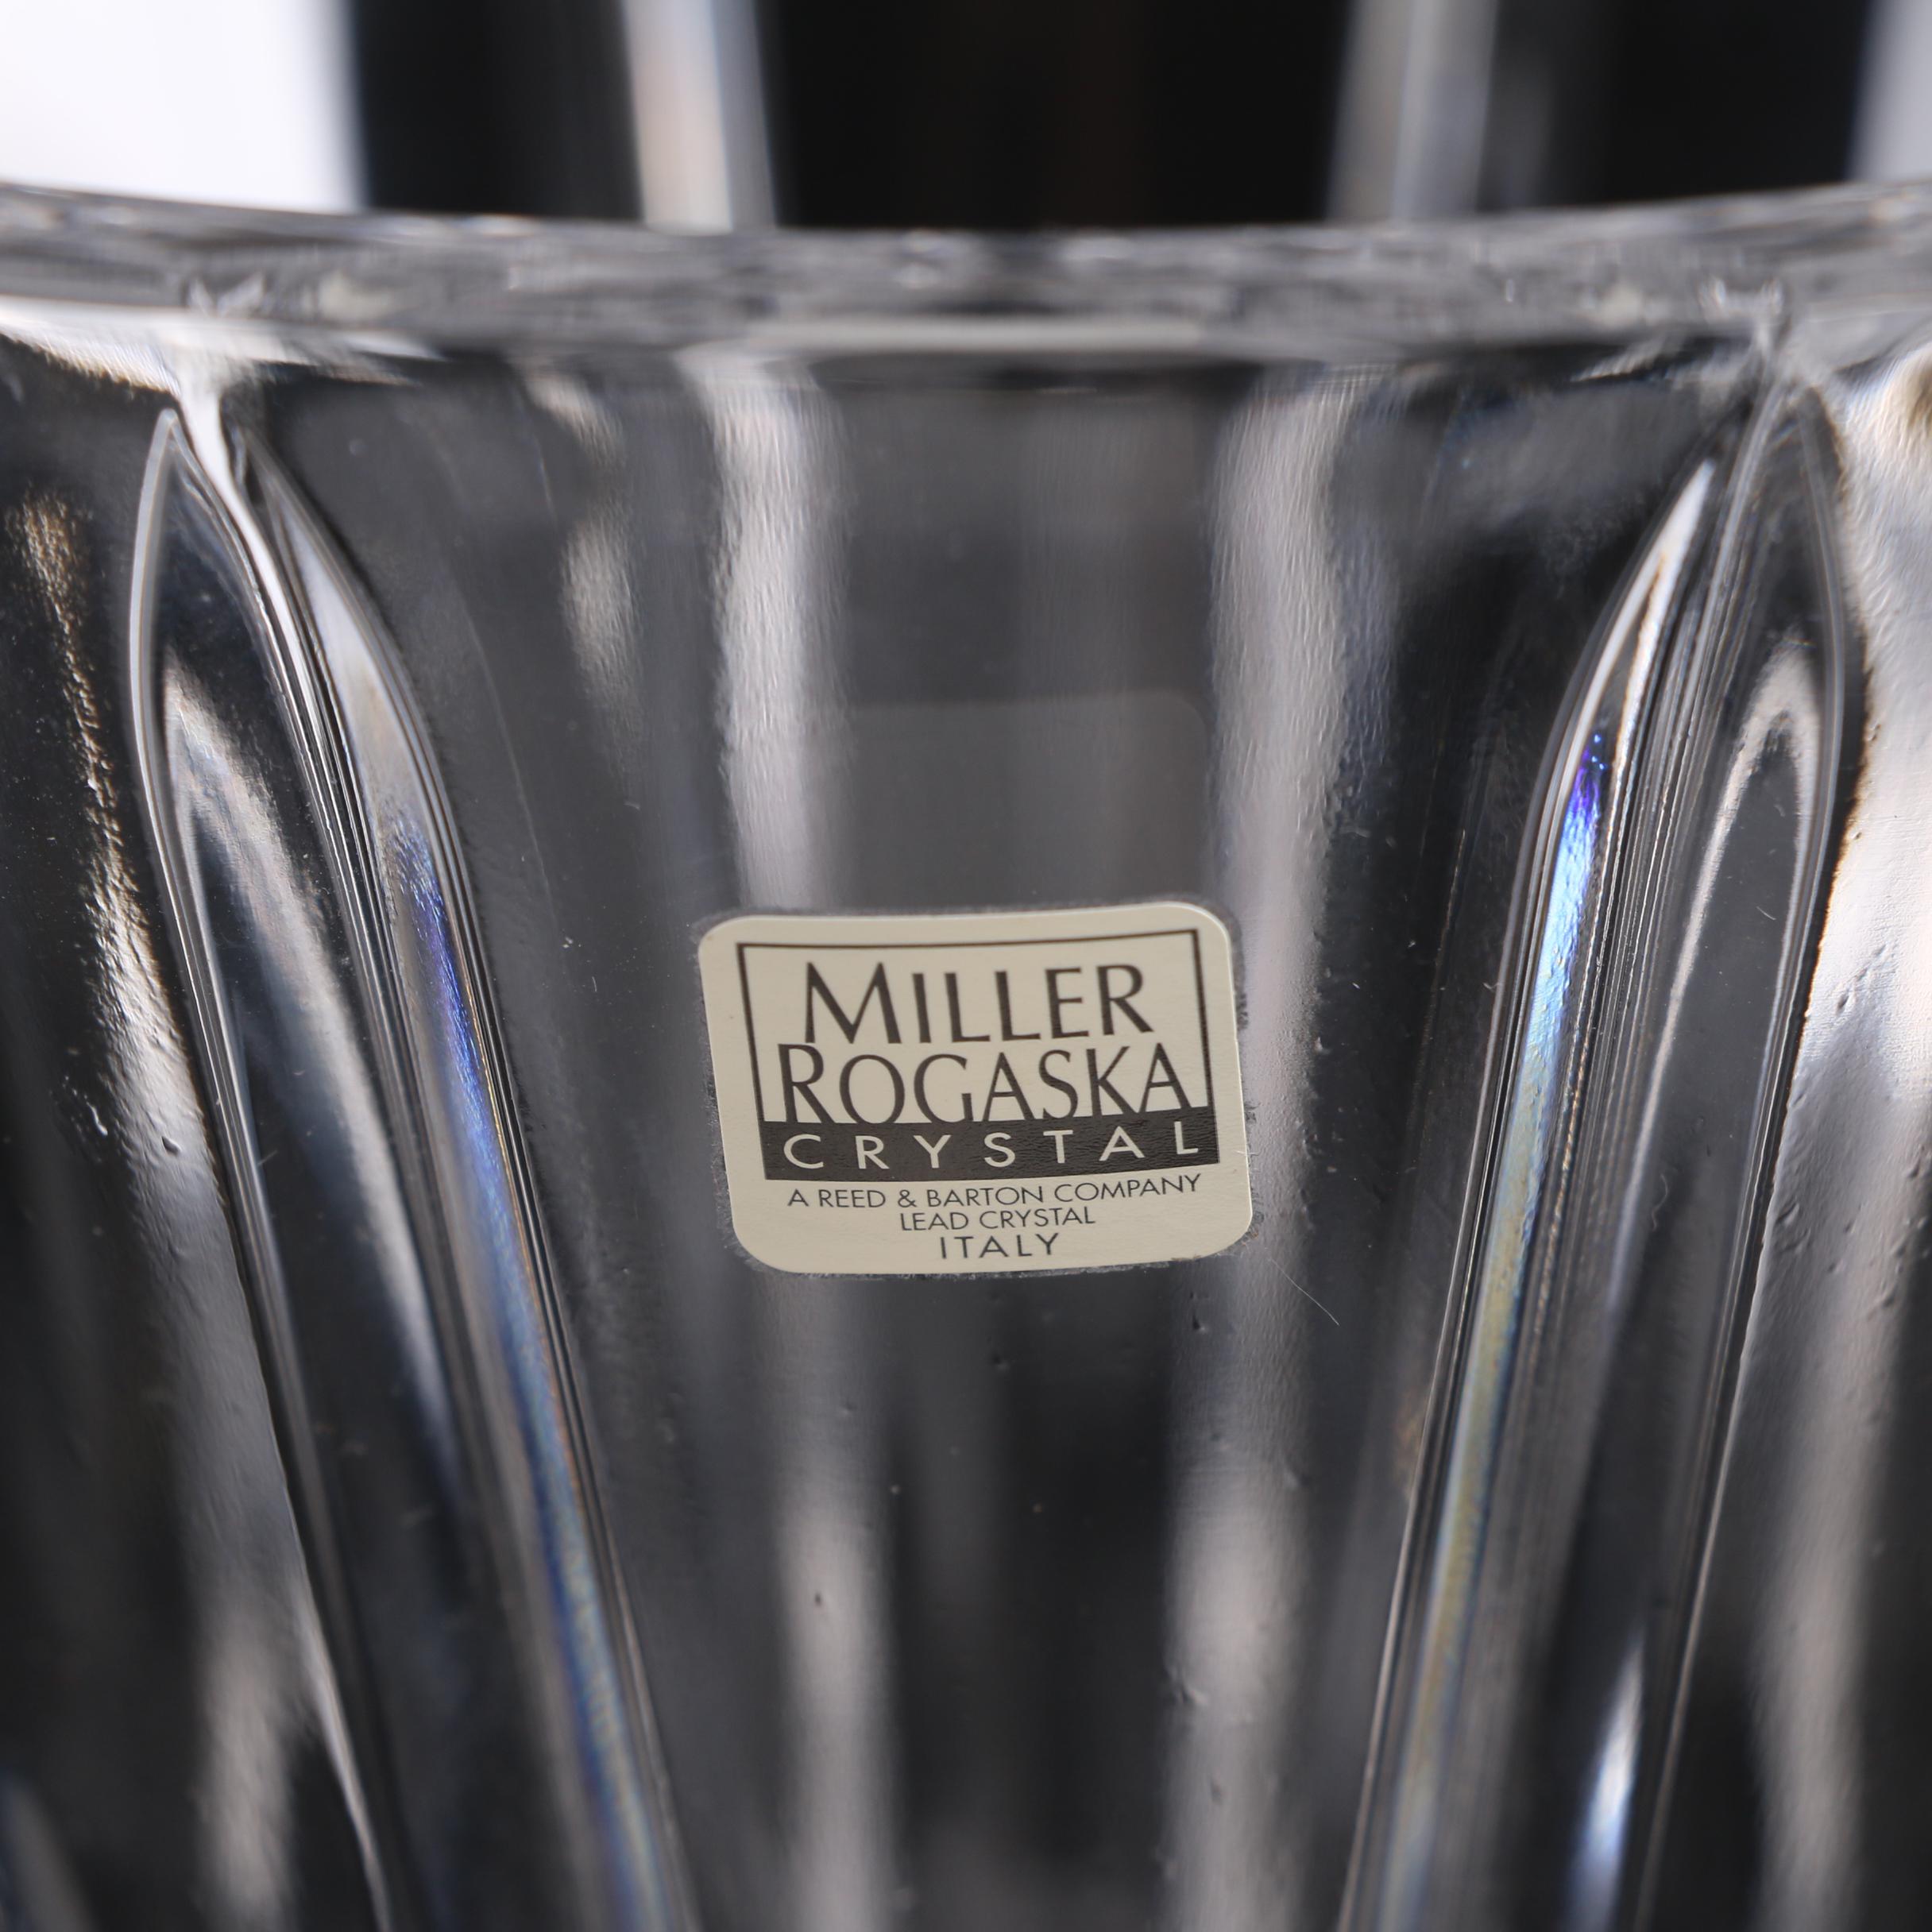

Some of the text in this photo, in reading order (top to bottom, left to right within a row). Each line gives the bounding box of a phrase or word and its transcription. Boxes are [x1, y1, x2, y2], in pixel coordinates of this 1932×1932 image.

[804, 961, 1154, 1044] MILLER
[777, 1042, 1192, 1124] ROGASKA
[782, 1121, 1200, 1170] CRYSTAL
[787, 1173, 1202, 1208] A REED & BARTON COMPANY
[900, 1206, 1095, 1231] LEAD CRYSTAL
[940, 1232, 1060, 1260] ITALY
